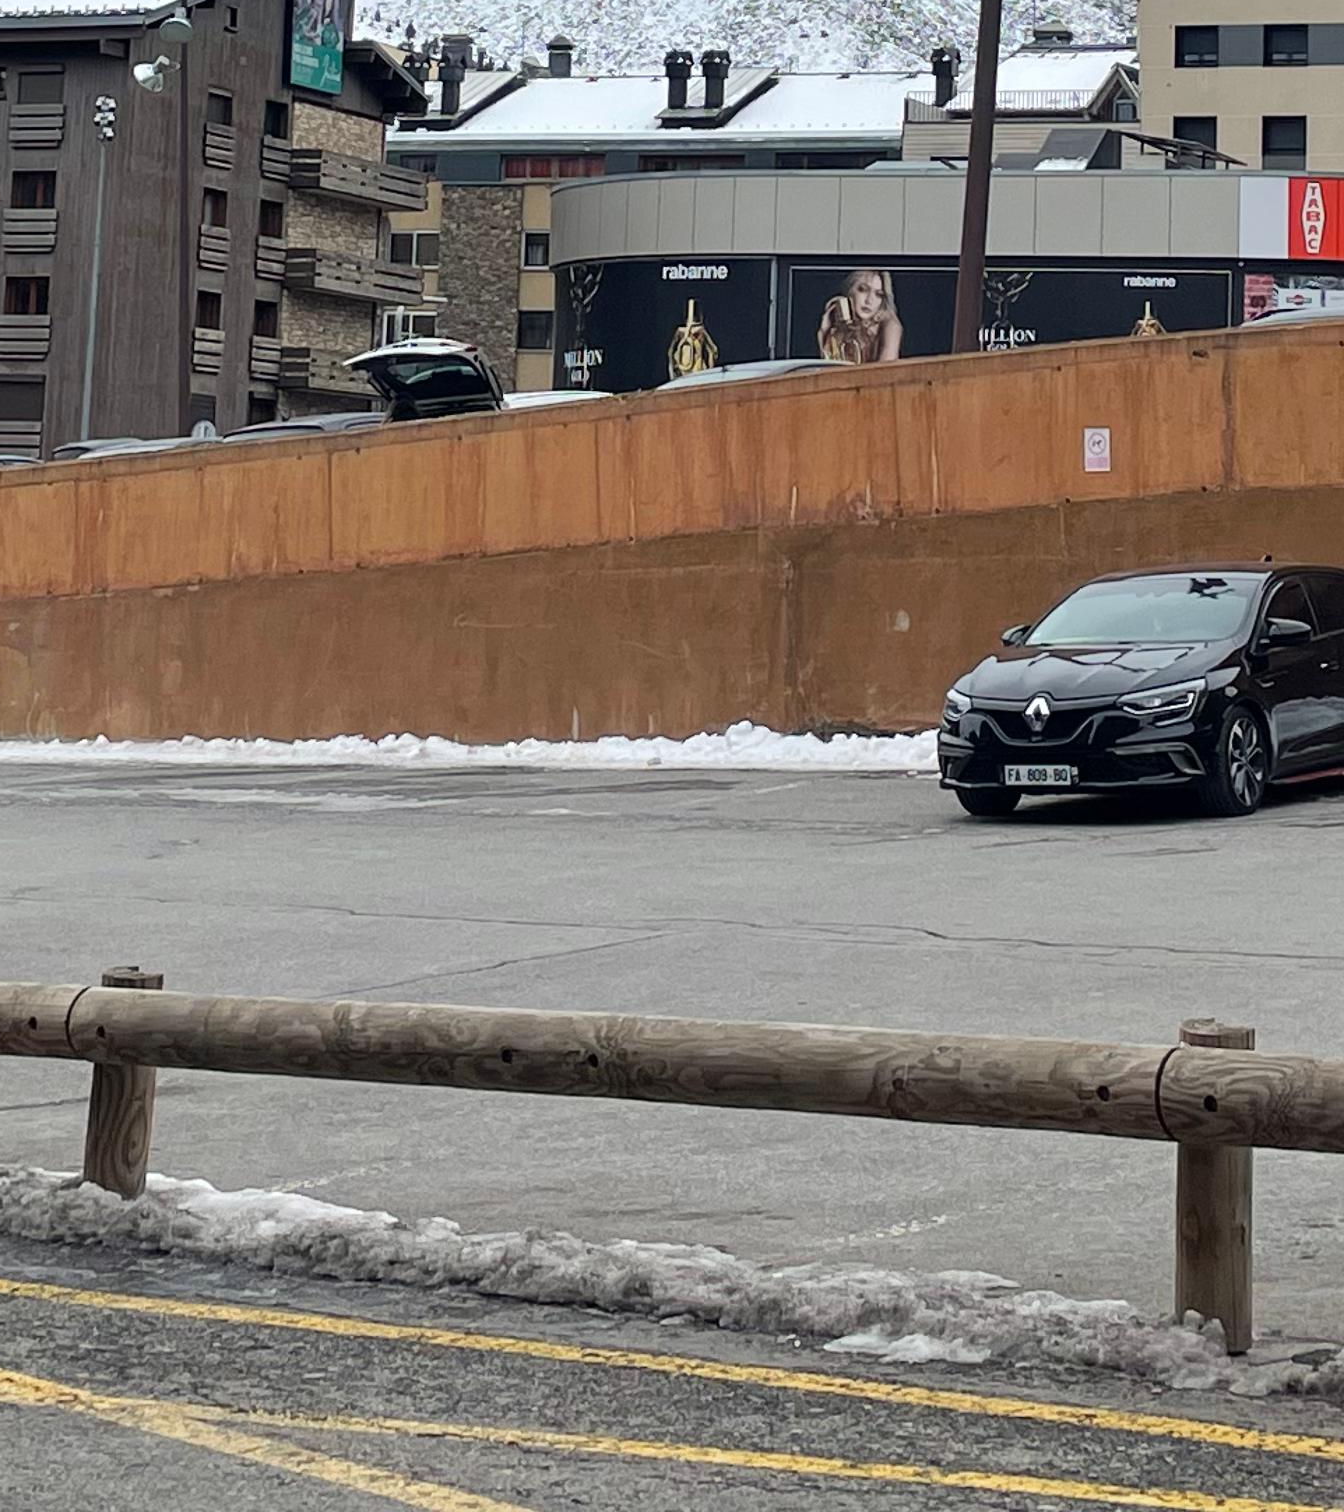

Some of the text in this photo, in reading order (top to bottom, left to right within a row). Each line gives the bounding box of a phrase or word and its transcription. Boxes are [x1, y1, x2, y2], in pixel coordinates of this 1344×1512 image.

[1306, 186, 1321, 250] TABAC
[662, 264, 728, 280] rabanne
[1123, 276, 1176, 288] rabanne
[978, 327, 1036, 342] ILLION
